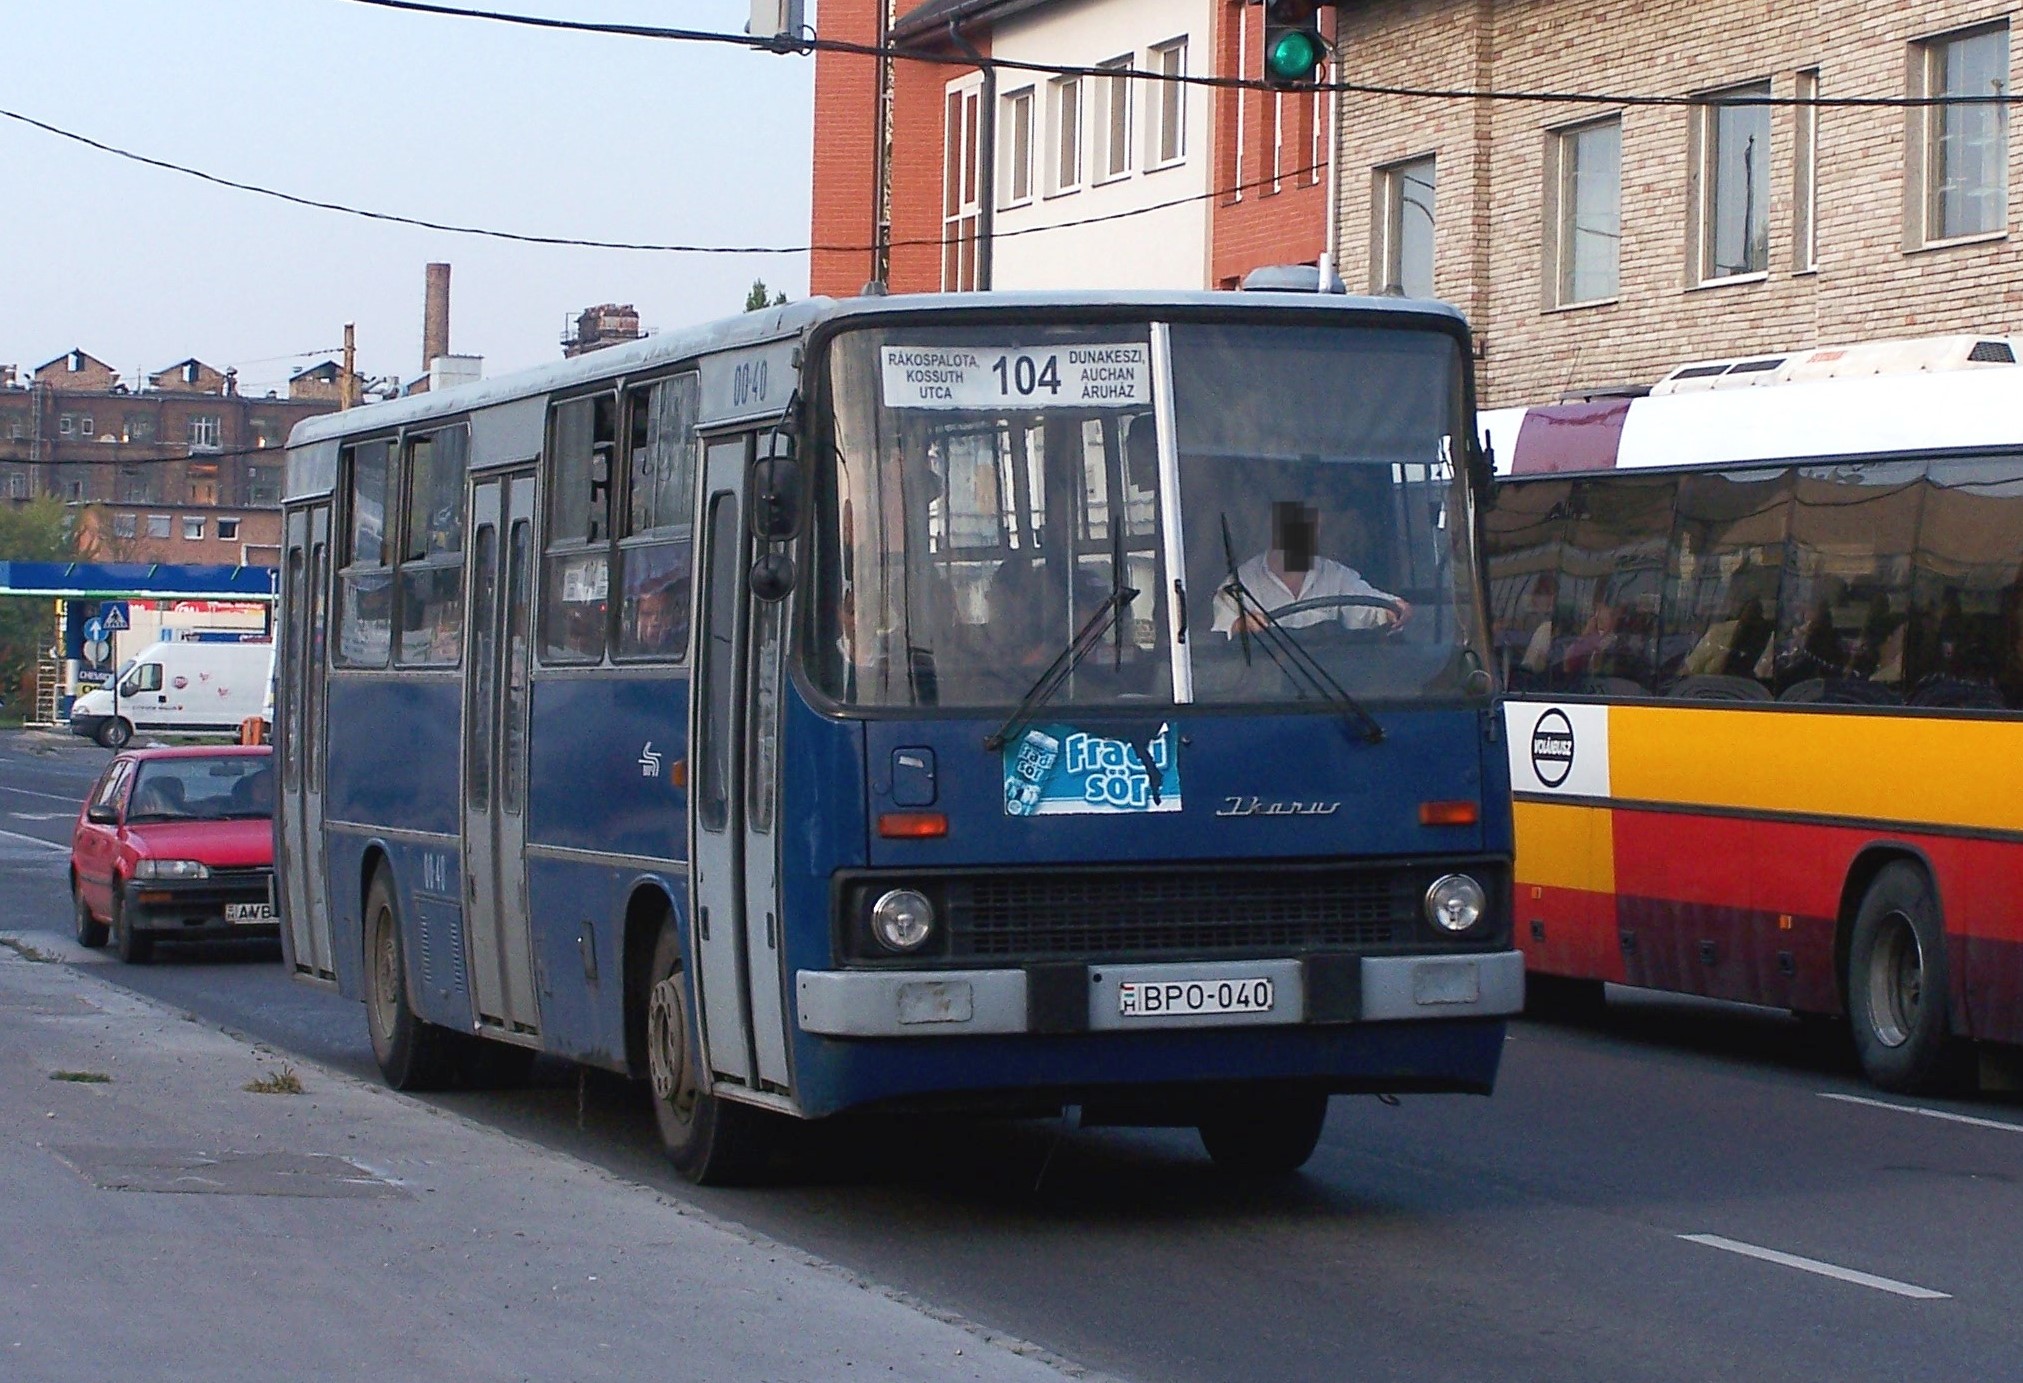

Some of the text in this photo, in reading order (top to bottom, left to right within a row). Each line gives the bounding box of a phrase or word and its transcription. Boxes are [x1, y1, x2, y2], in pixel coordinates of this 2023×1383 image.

[1069, 350, 1145, 365] DUNAKESZI,
[906, 370, 964, 383] KOSSUTH
[992, 355, 1061, 395] 104
[1080, 367, 1134, 381] AUCHAN
[919, 386, 953, 399] UTCA
[1081, 382, 1135, 399] ÁRUHÁZ
[1085, 767, 1150, 808] sör
[1216, 796, 1341, 816] Ikarus
[1144, 981, 1268, 1011] BPO-040
